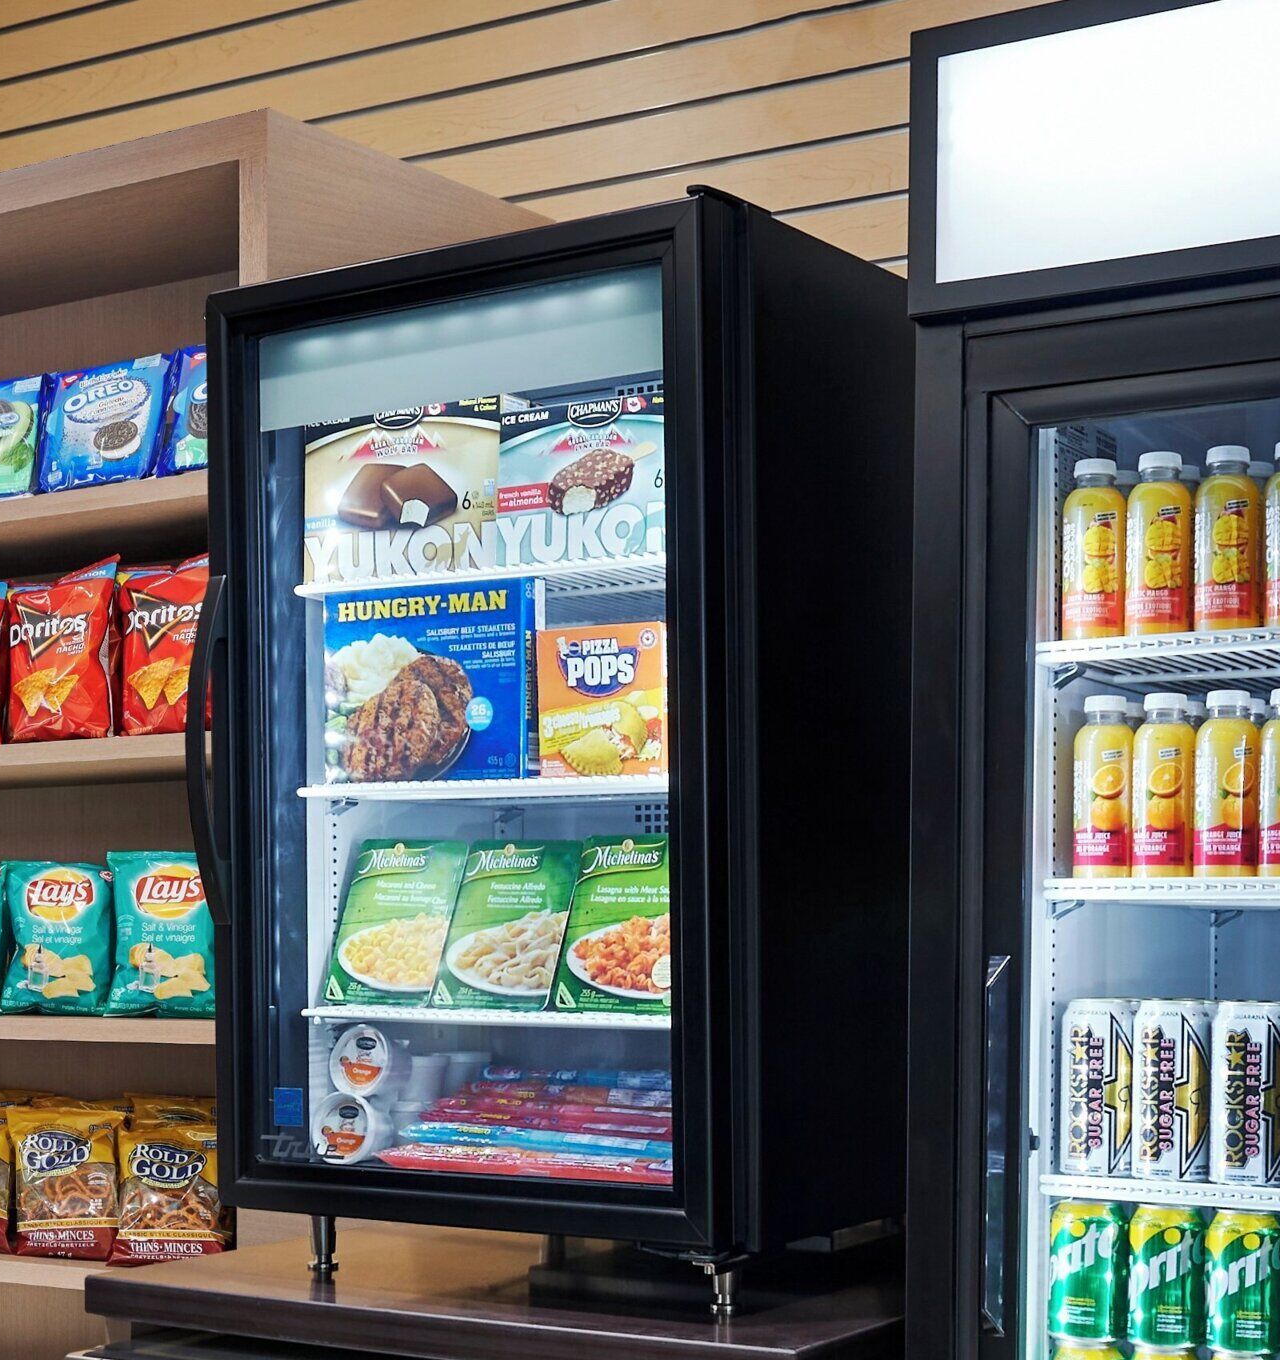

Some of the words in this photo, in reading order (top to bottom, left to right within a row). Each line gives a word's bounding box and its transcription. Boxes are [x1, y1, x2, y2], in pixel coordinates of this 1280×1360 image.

[63, 380, 134, 413] OREO
[570, 399, 622, 419] CHAPMAN'S
[502, 416, 516, 426] ICE
[518, 411, 550, 424] CREAM
[654, 468, 664, 488] 6
[462, 489, 471, 510] 6
[304, 520, 496, 584] YUKON
[338, 590, 508, 623] HUNGRY-MAN
[10, 613, 87, 646] Doritos
[426, 627, 460, 637] SALISBURY
[482, 650, 516, 659] SALISBURY
[582, 638, 619, 655] PIZZA
[567, 653, 635, 687] POPS
[358, 849, 427, 875] Michelina's
[466, 850, 539, 876] Michelina's
[582, 846, 659, 873] Michelina's
[27, 879, 92, 909] Lay's
[136, 875, 203, 904] Lay's
[142, 923, 156, 933] Salt
[142, 933, 153, 942] Sel
[1089, 1037, 1103, 1080] FREE
[1160, 1038, 1175, 1081] FREE
[1246, 1042, 1262, 1087] FREE
[1088, 1086, 1103, 1148] SUGAR
[1159, 1090, 1174, 1152] SUGAR
[1245, 1095, 1260, 1157] SUGAR
[136, 1143, 188, 1163] ROLD
[131, 1159, 202, 1180] GOLD
